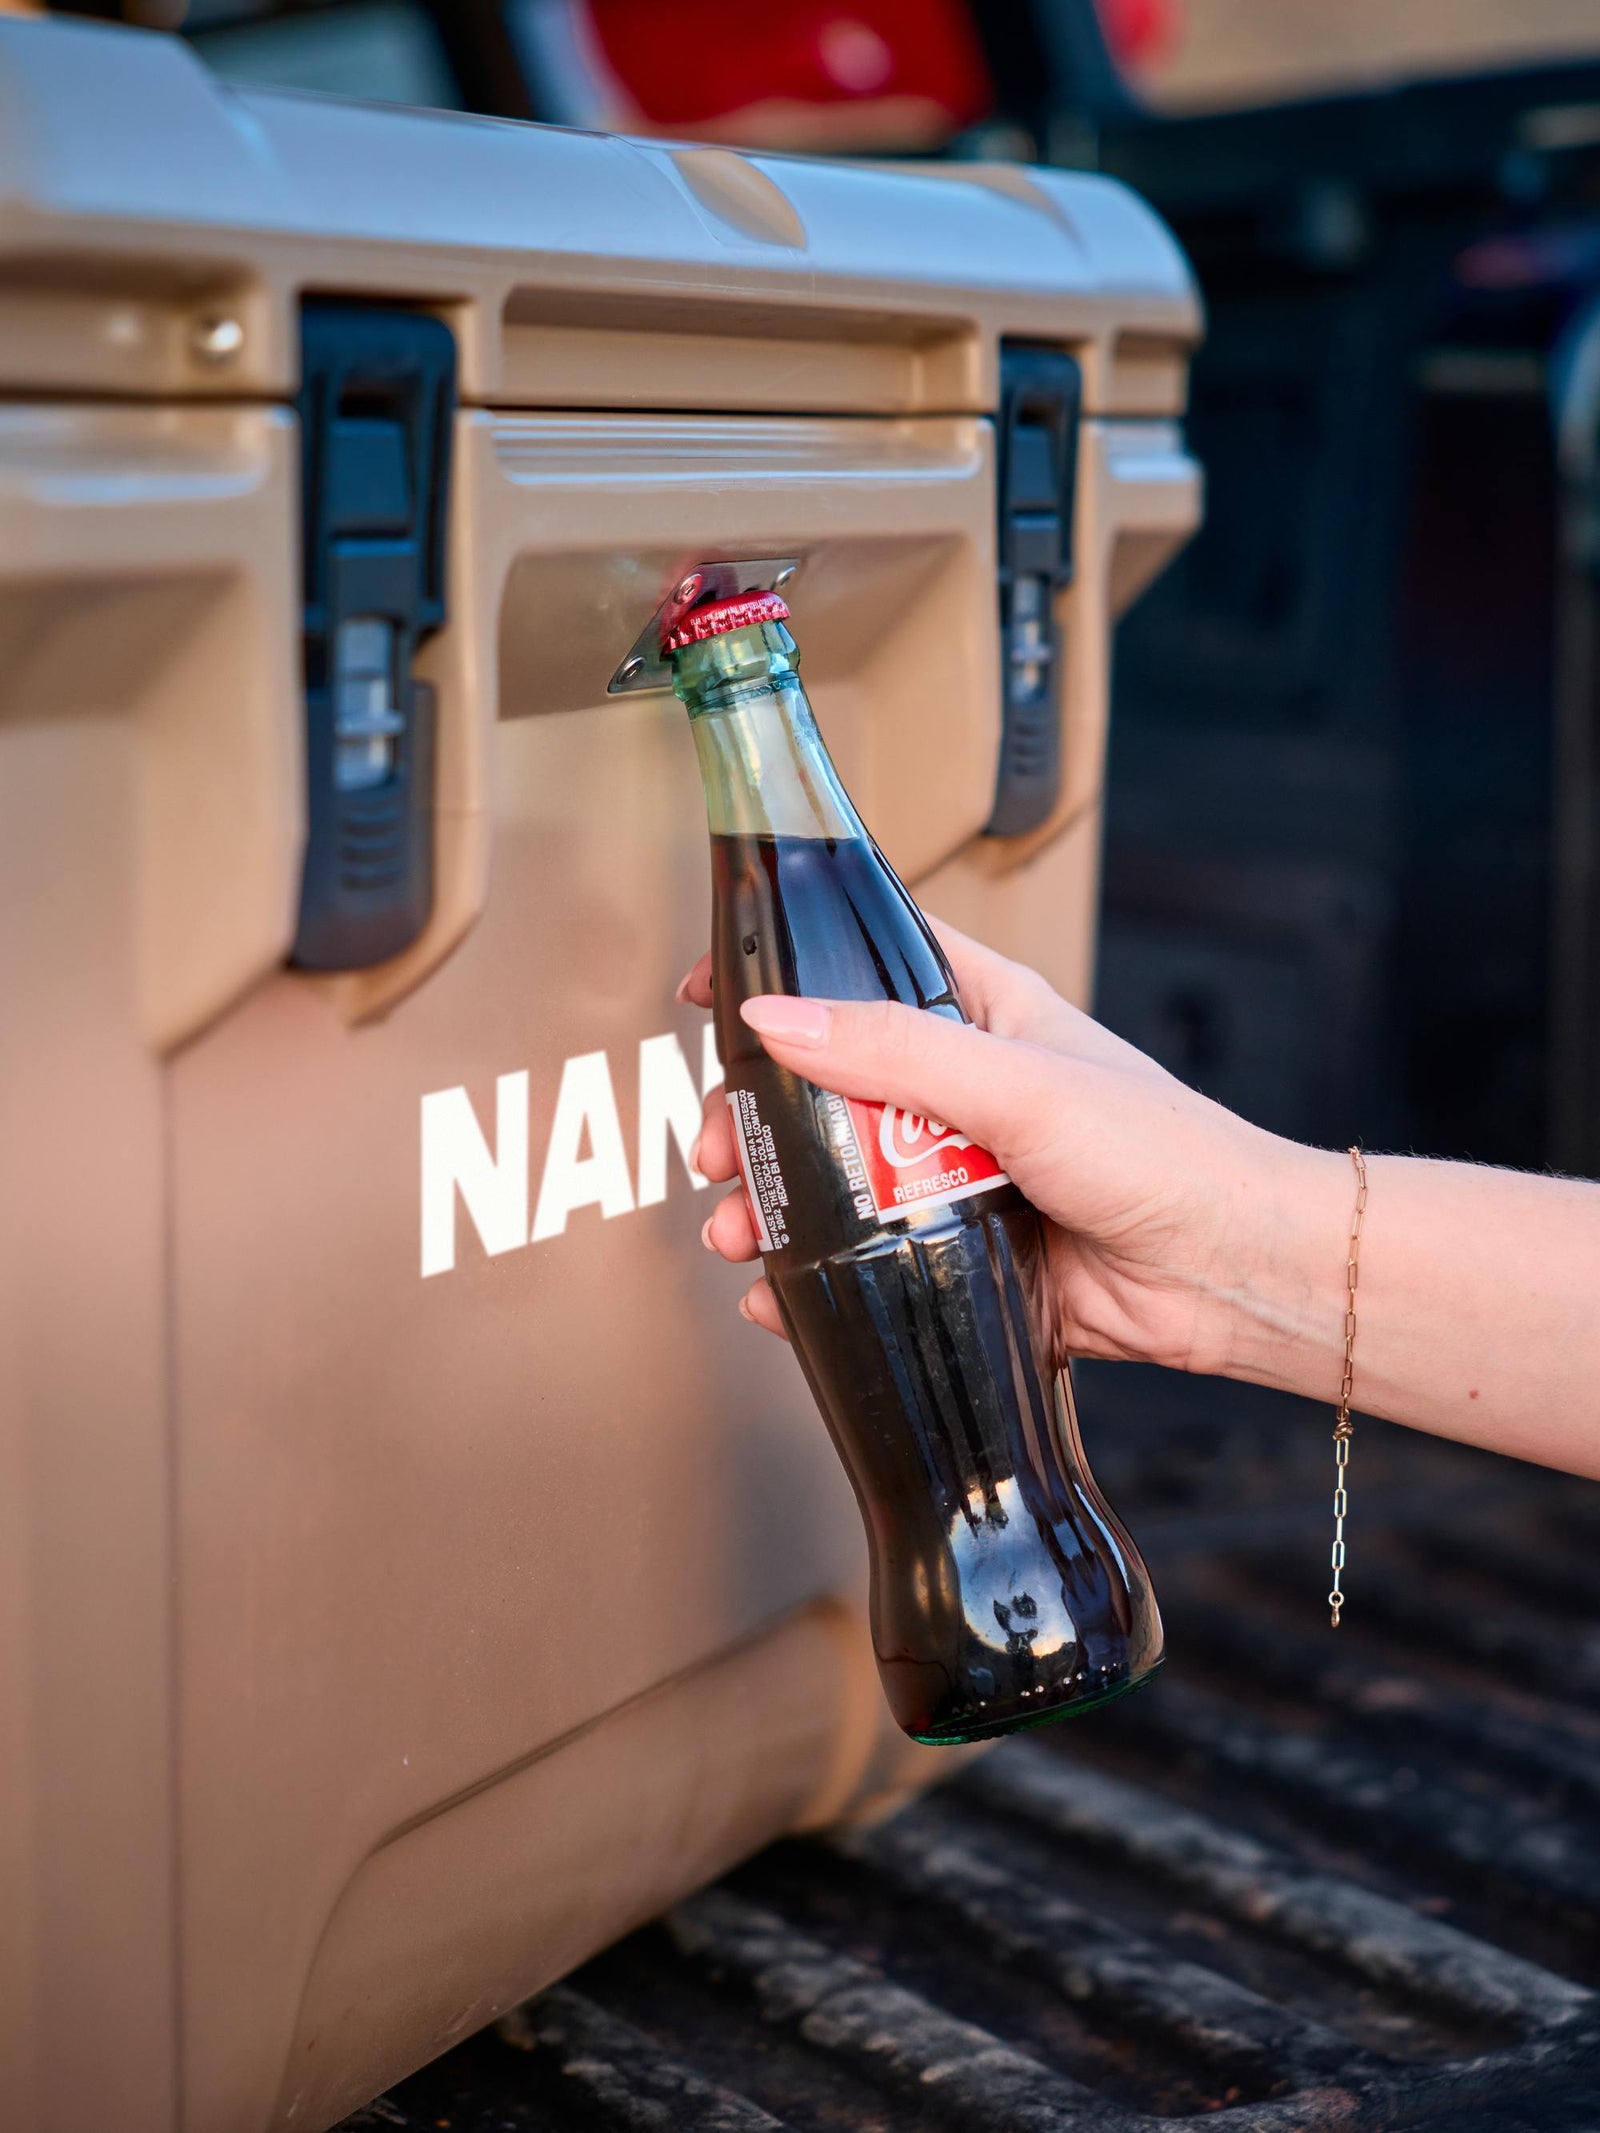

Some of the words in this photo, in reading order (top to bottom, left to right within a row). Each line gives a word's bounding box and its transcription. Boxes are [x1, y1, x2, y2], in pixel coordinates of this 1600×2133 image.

[738, 1089, 754, 1137] REFRESCO
[747, 1091, 762, 1136] COMPANY
[747, 1137, 759, 1163] PARA
[761, 1124, 778, 1161] MEXICO
[755, 1136, 774, 1188] COCA-COLA
[769, 1161, 781, 1175] EN
[753, 1164, 772, 1213] EXCLUSIVO
[768, 1188, 779, 1208] THE
[773, 1175, 790, 1207] HECHO
[892, 1166, 969, 1204] REFRESCO
[773, 1208, 786, 1230] 2002
[853, 1194, 876, 1221] NO
[766, 1214, 783, 1250] ENVASE
